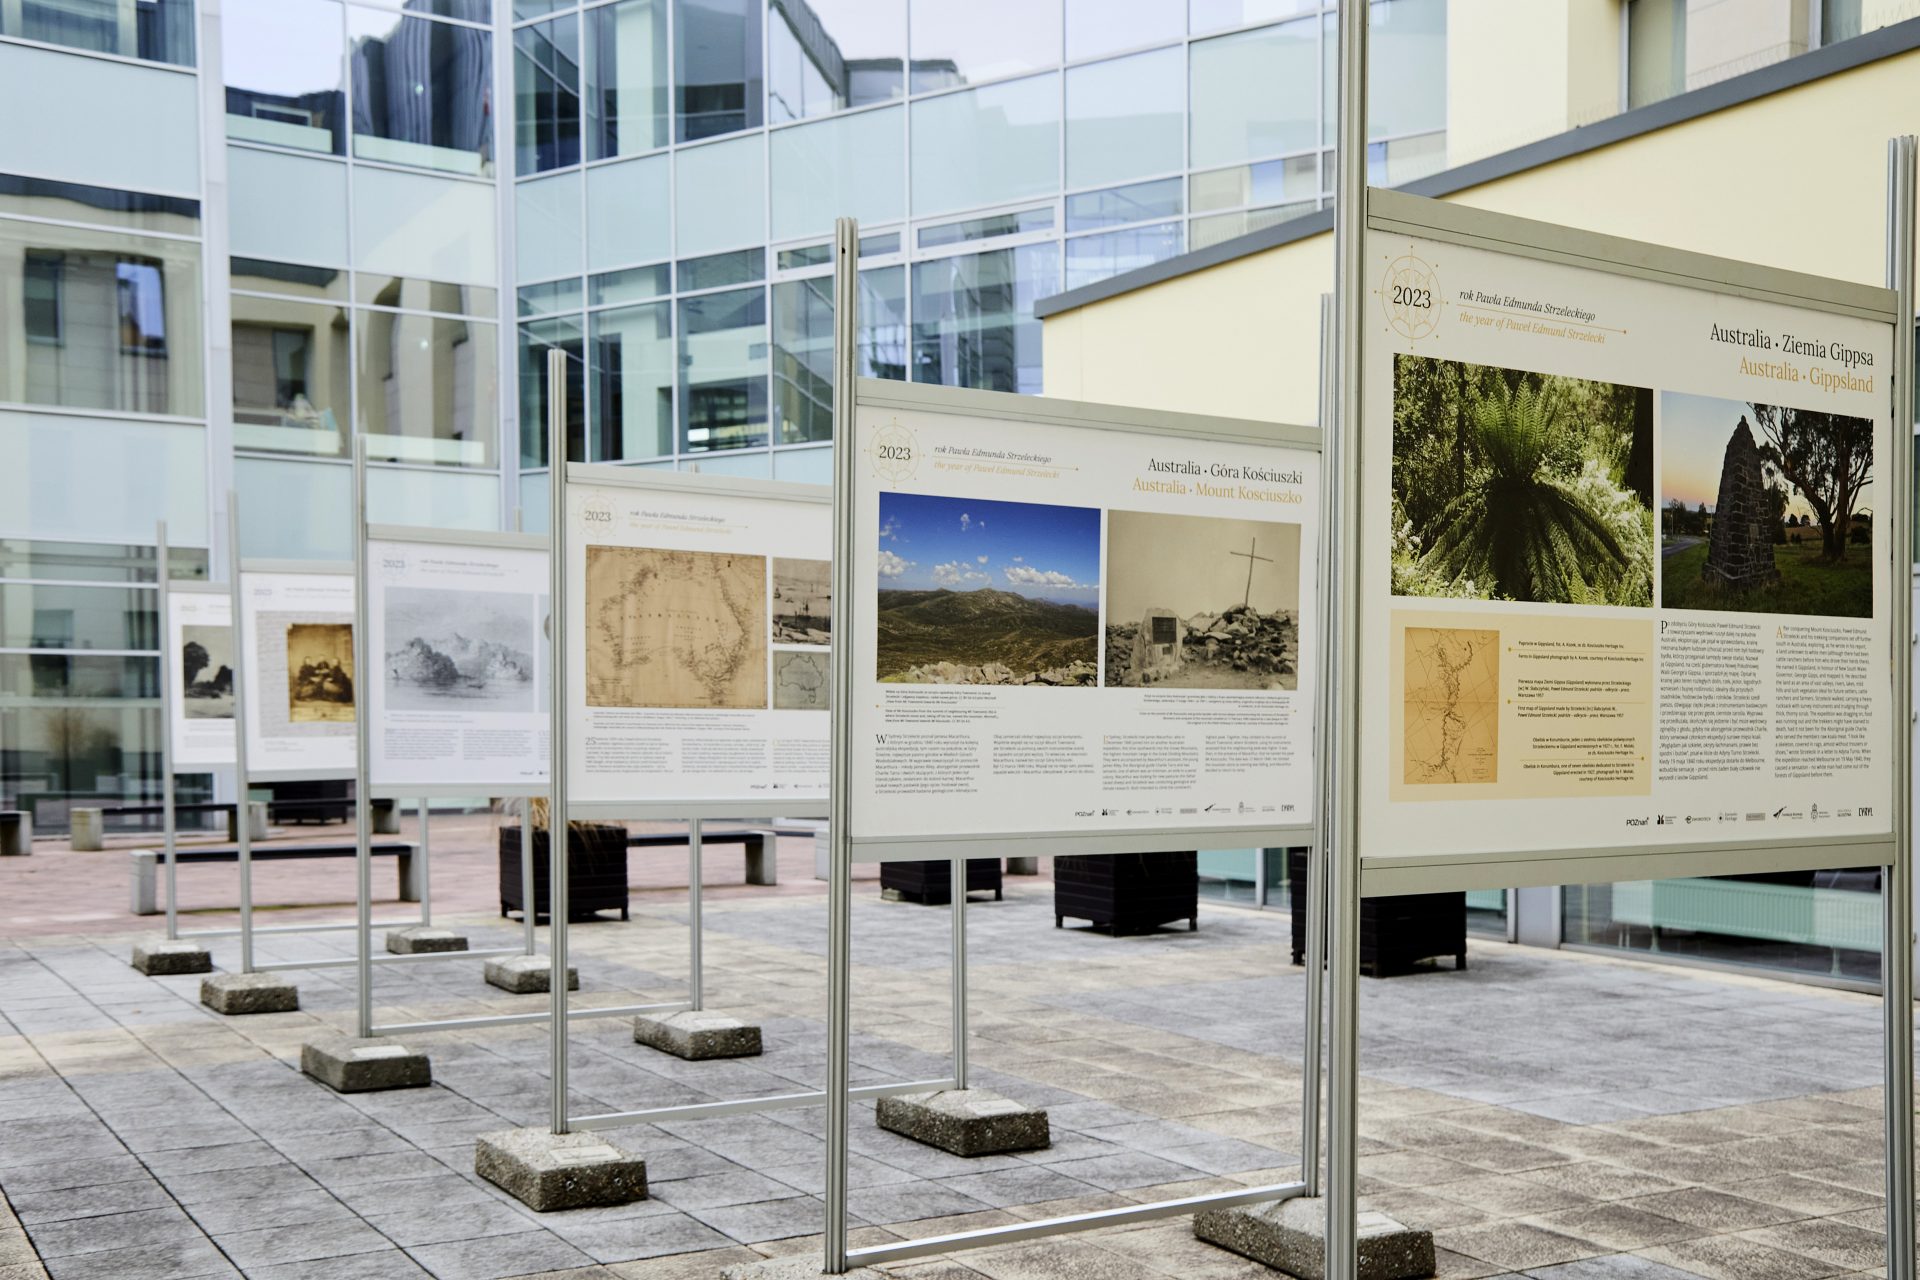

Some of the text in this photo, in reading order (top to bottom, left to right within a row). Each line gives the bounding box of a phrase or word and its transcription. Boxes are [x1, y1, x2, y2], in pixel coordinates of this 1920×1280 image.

[1393, 285, 1431, 309] 2023
[1460, 290, 1595, 323] rok Pawła Edmunda Strzeleckiego
[1460, 311, 1473, 323] the
[1475, 317, 1493, 327] year
[1496, 318, 1504, 329] of
[1532, 323, 1565, 338] Edmund
[1566, 328, 1605, 344] Strzelecki
[1710, 323, 1873, 368] Australia Ziemia Gippsa
[1740, 356, 1873, 393] Australia Gippsland
[879, 446, 911, 460] 2023
[935, 446, 946, 454] rok
[972, 448, 1005, 459] Edmunda
[1007, 452, 1051, 464] Strzeleckiego
[934, 461, 946, 469] the
[965, 463, 972, 472] of
[996, 466, 1024, 475] Edmund
[1025, 468, 1060, 478] Strzelecki
[1148, 458, 1302, 484] Australia Góra Kościuszki
[1133, 477, 1302, 504] Australia Mount Kosciuszko
[585, 510, 611, 522] 2023
[876, 734, 887, 744] W
